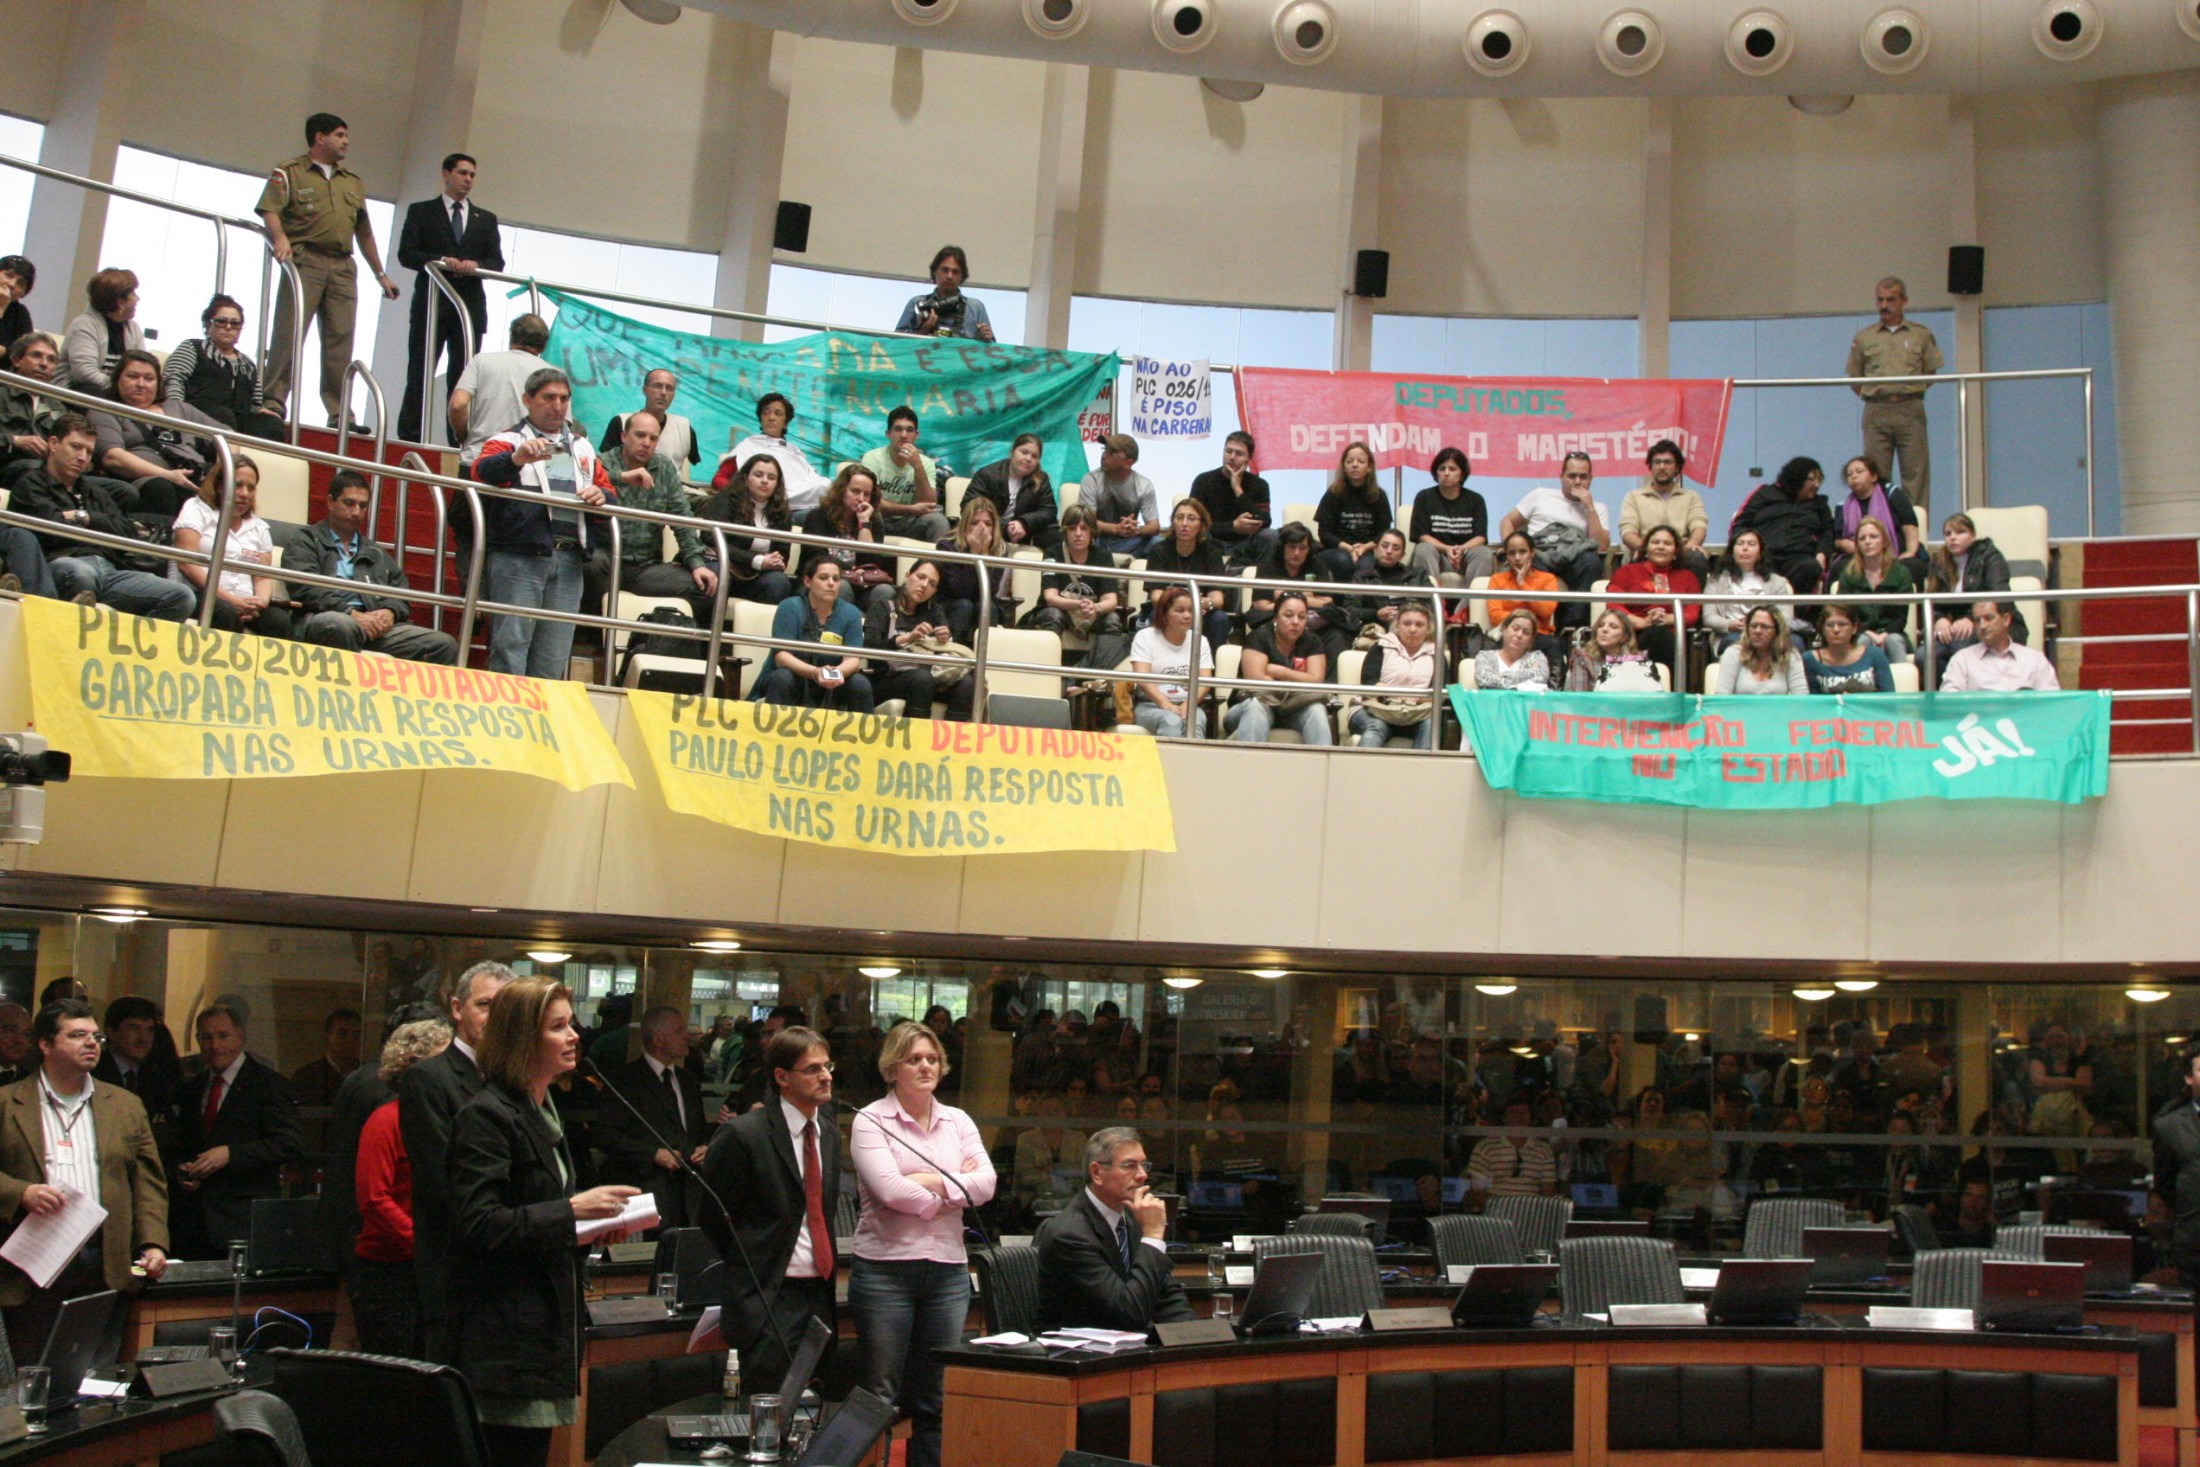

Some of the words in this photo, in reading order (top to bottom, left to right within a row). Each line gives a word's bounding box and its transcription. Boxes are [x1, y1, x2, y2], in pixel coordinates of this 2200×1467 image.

[1136, 357, 1160, 375] NÃO
[1165, 362, 1191, 377] AO
[1136, 377, 1157, 396] PLC
[1141, 396, 1148, 414] É
[1154, 398, 1197, 416] PISO
[1395, 382, 1574, 419] DEPUTADOS,
[1132, 416, 1148, 433] NA
[1290, 422, 1442, 455] DEFENDAM
[1469, 431, 1488, 459] O
[79, 604, 158, 660] PLC
[177, 622, 351, 687] 026/2011
[353, 652, 549, 711] DEPUTADOS:
[81, 658, 277, 727] GAROPABA
[292, 683, 383, 734] DARÁ
[392, 695, 560, 753] RESPOSTA
[671, 694, 738, 731] PLC
[753, 700, 912, 750] 026/2011
[931, 719, 1125, 762] DEPUTADOS:
[1529, 710, 1746, 752] INTERVENÇÃO
[1788, 718, 1939, 749] FEDERAL
[1932, 713, 2036, 777] JÁ!
[203, 732, 295, 776] NAS
[323, 736, 492, 771] URNAS.
[669, 730, 763, 779] PAULO
[772, 744, 861, 792] LOPES
[876, 756, 953, 802] DARÁ
[963, 765, 1124, 808] RESPOSTA
[1721, 748, 1847, 783] ESTADO
[769, 793, 836, 842] NAS
[855, 803, 1005, 849] URNAS.
